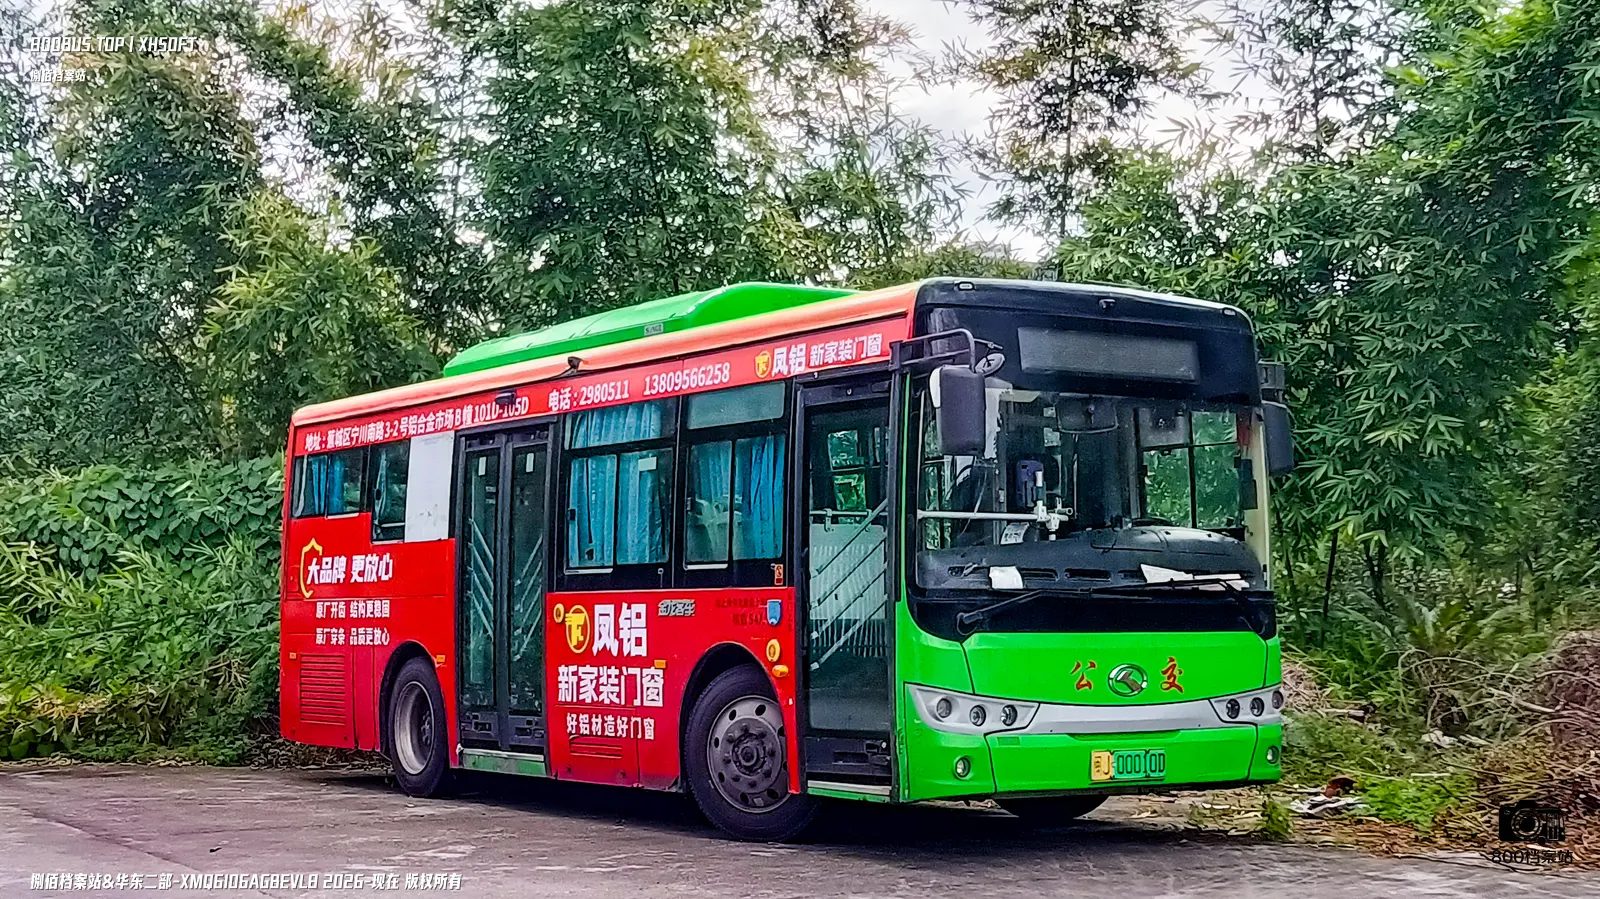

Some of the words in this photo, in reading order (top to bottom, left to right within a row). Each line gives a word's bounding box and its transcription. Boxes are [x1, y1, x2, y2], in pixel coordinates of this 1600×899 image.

[772, 343, 806, 377] 凤铝
[810, 333, 882, 367] 新家装门窗
[643, 362, 731, 396] 13809566258
[306, 556, 347, 584] 大品牌
[350, 553, 393, 583] 更放心
[350, 627, 390, 645] 品质更放心
[592, 602, 647, 656] 凤铝
[557, 665, 664, 707] 新家装门窗
[566, 713, 655, 740] 好铝材造好门窗
